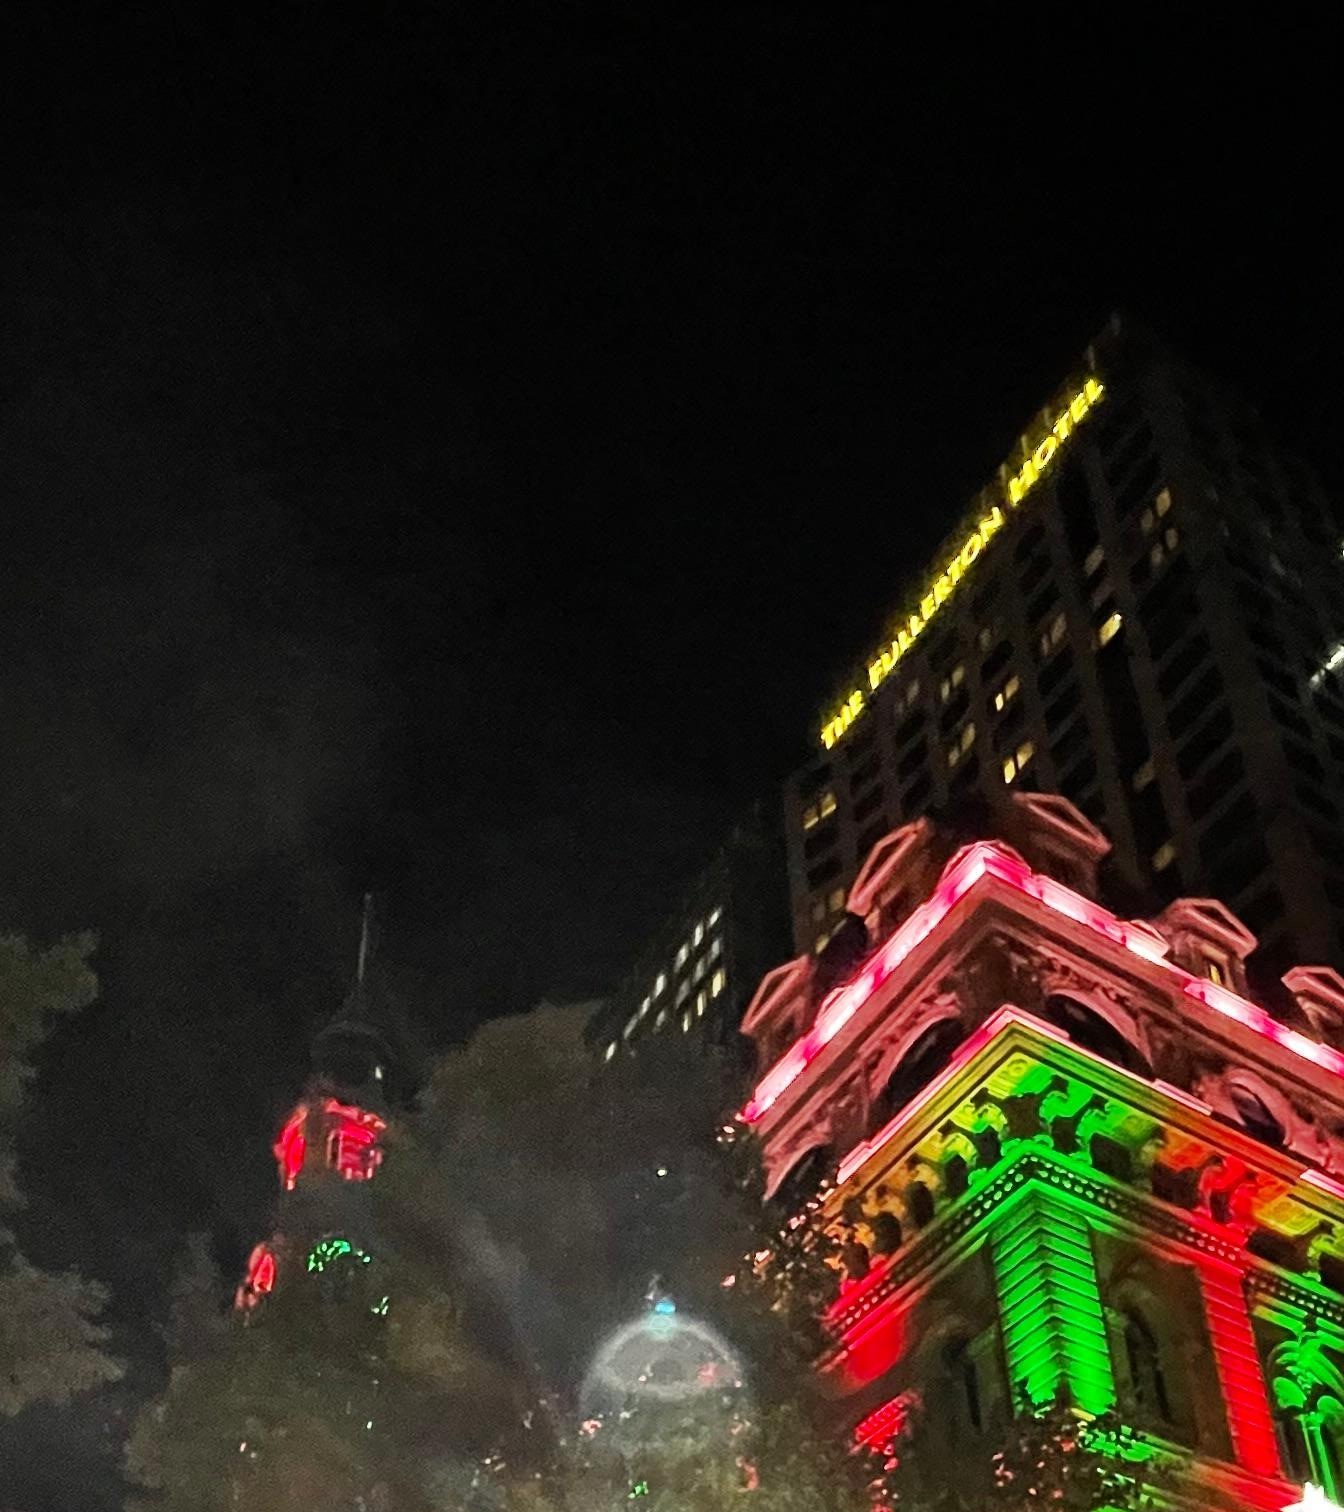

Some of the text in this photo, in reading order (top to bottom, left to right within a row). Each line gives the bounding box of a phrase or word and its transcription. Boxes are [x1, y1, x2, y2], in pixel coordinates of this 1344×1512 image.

[820, 378, 1105, 750] THE FULLERTON HOTEL
